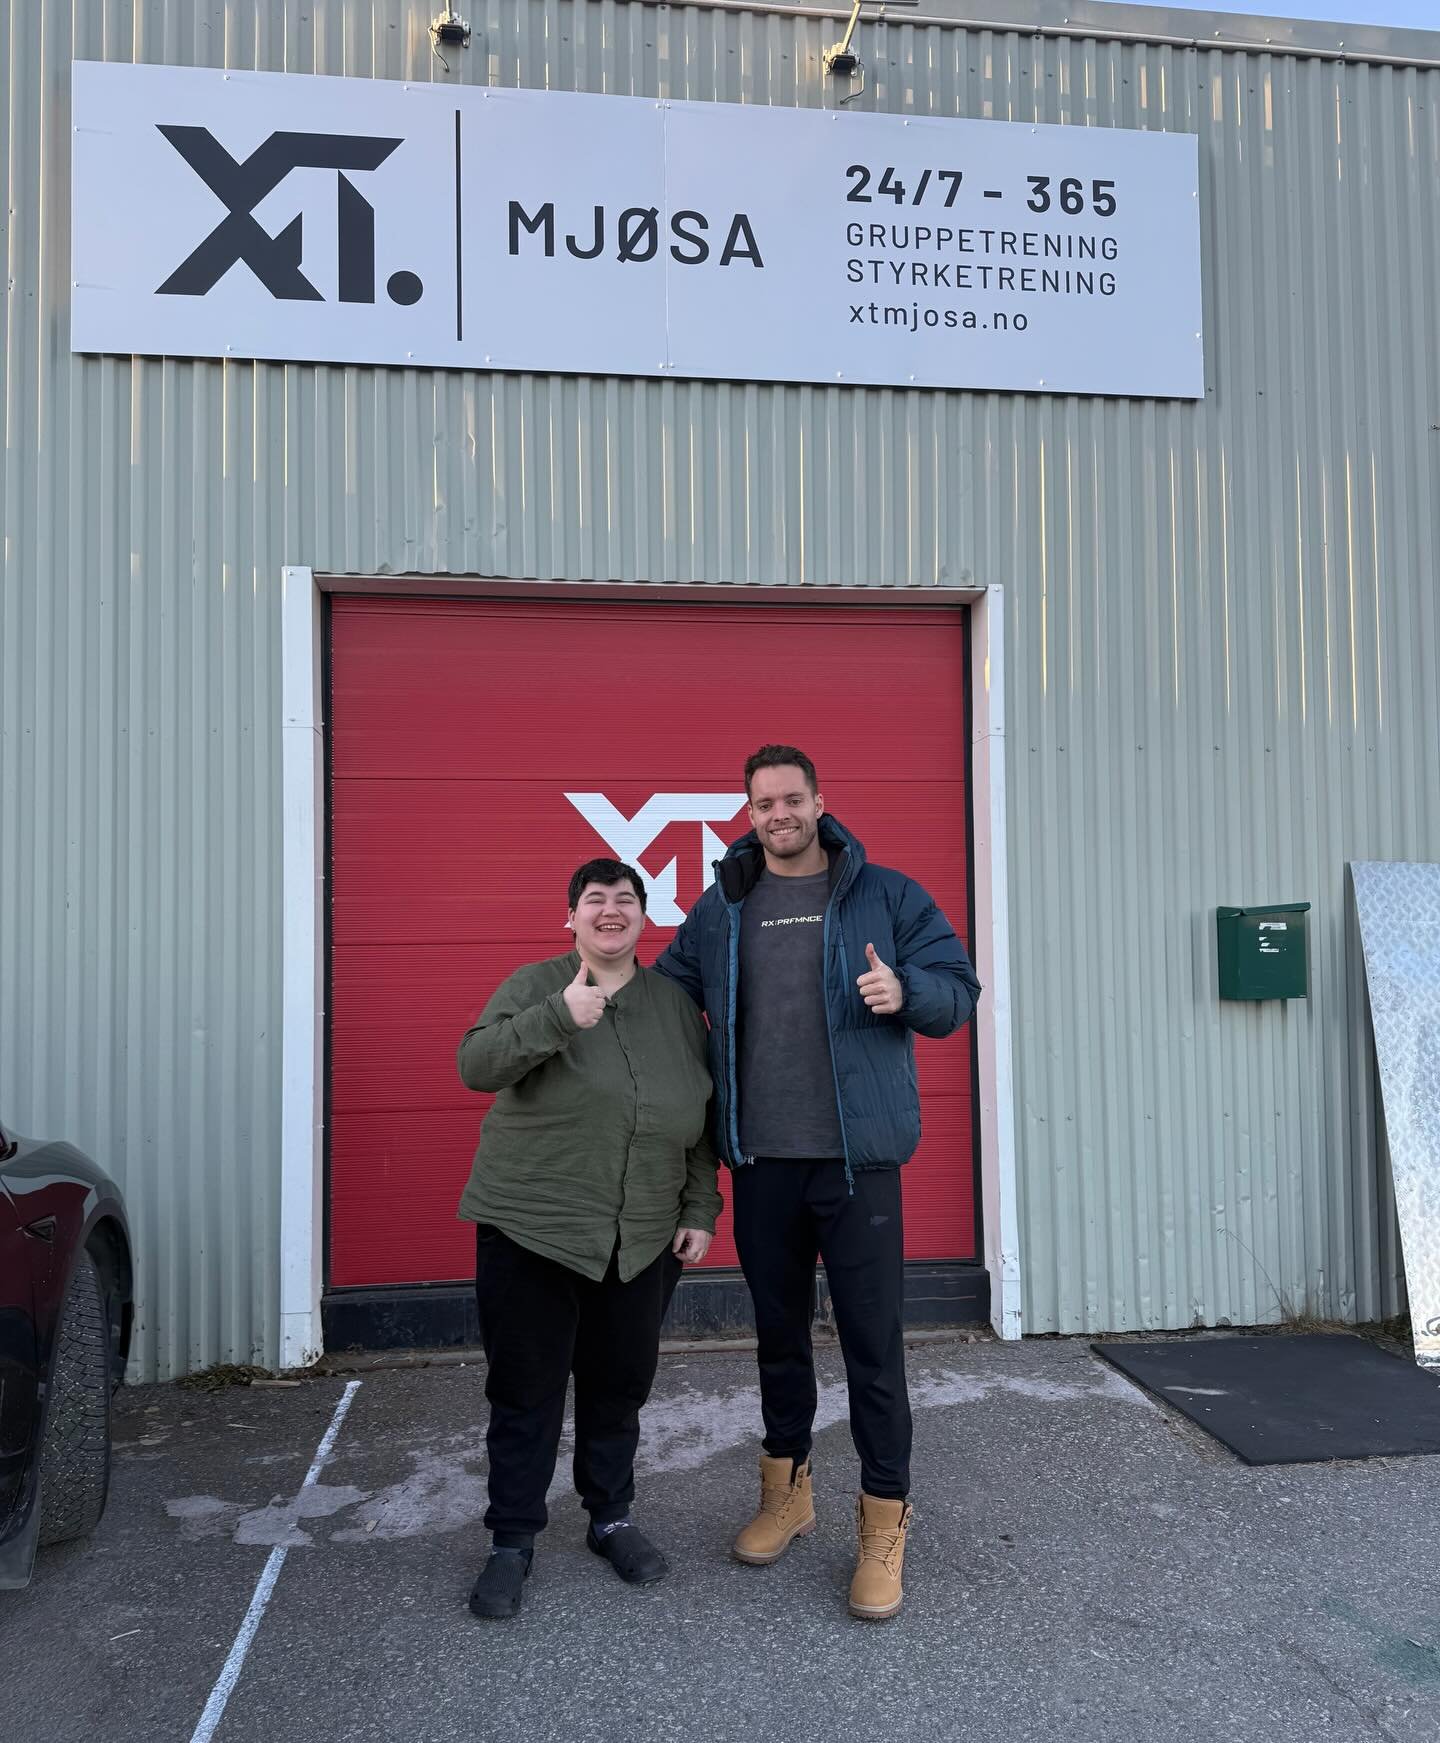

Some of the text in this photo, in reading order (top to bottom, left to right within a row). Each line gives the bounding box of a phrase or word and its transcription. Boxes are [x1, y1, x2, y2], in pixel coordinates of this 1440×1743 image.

[846, 164, 963, 208] 24/7
[1026, 175, 1117, 217] 365
[508, 200, 765, 268] MJØSA
[846, 222, 1118, 261] GRUPPETRENING
[846, 258, 1116, 296] STYRKETRENING
[849, 302, 1028, 333] xtmjosa.no
